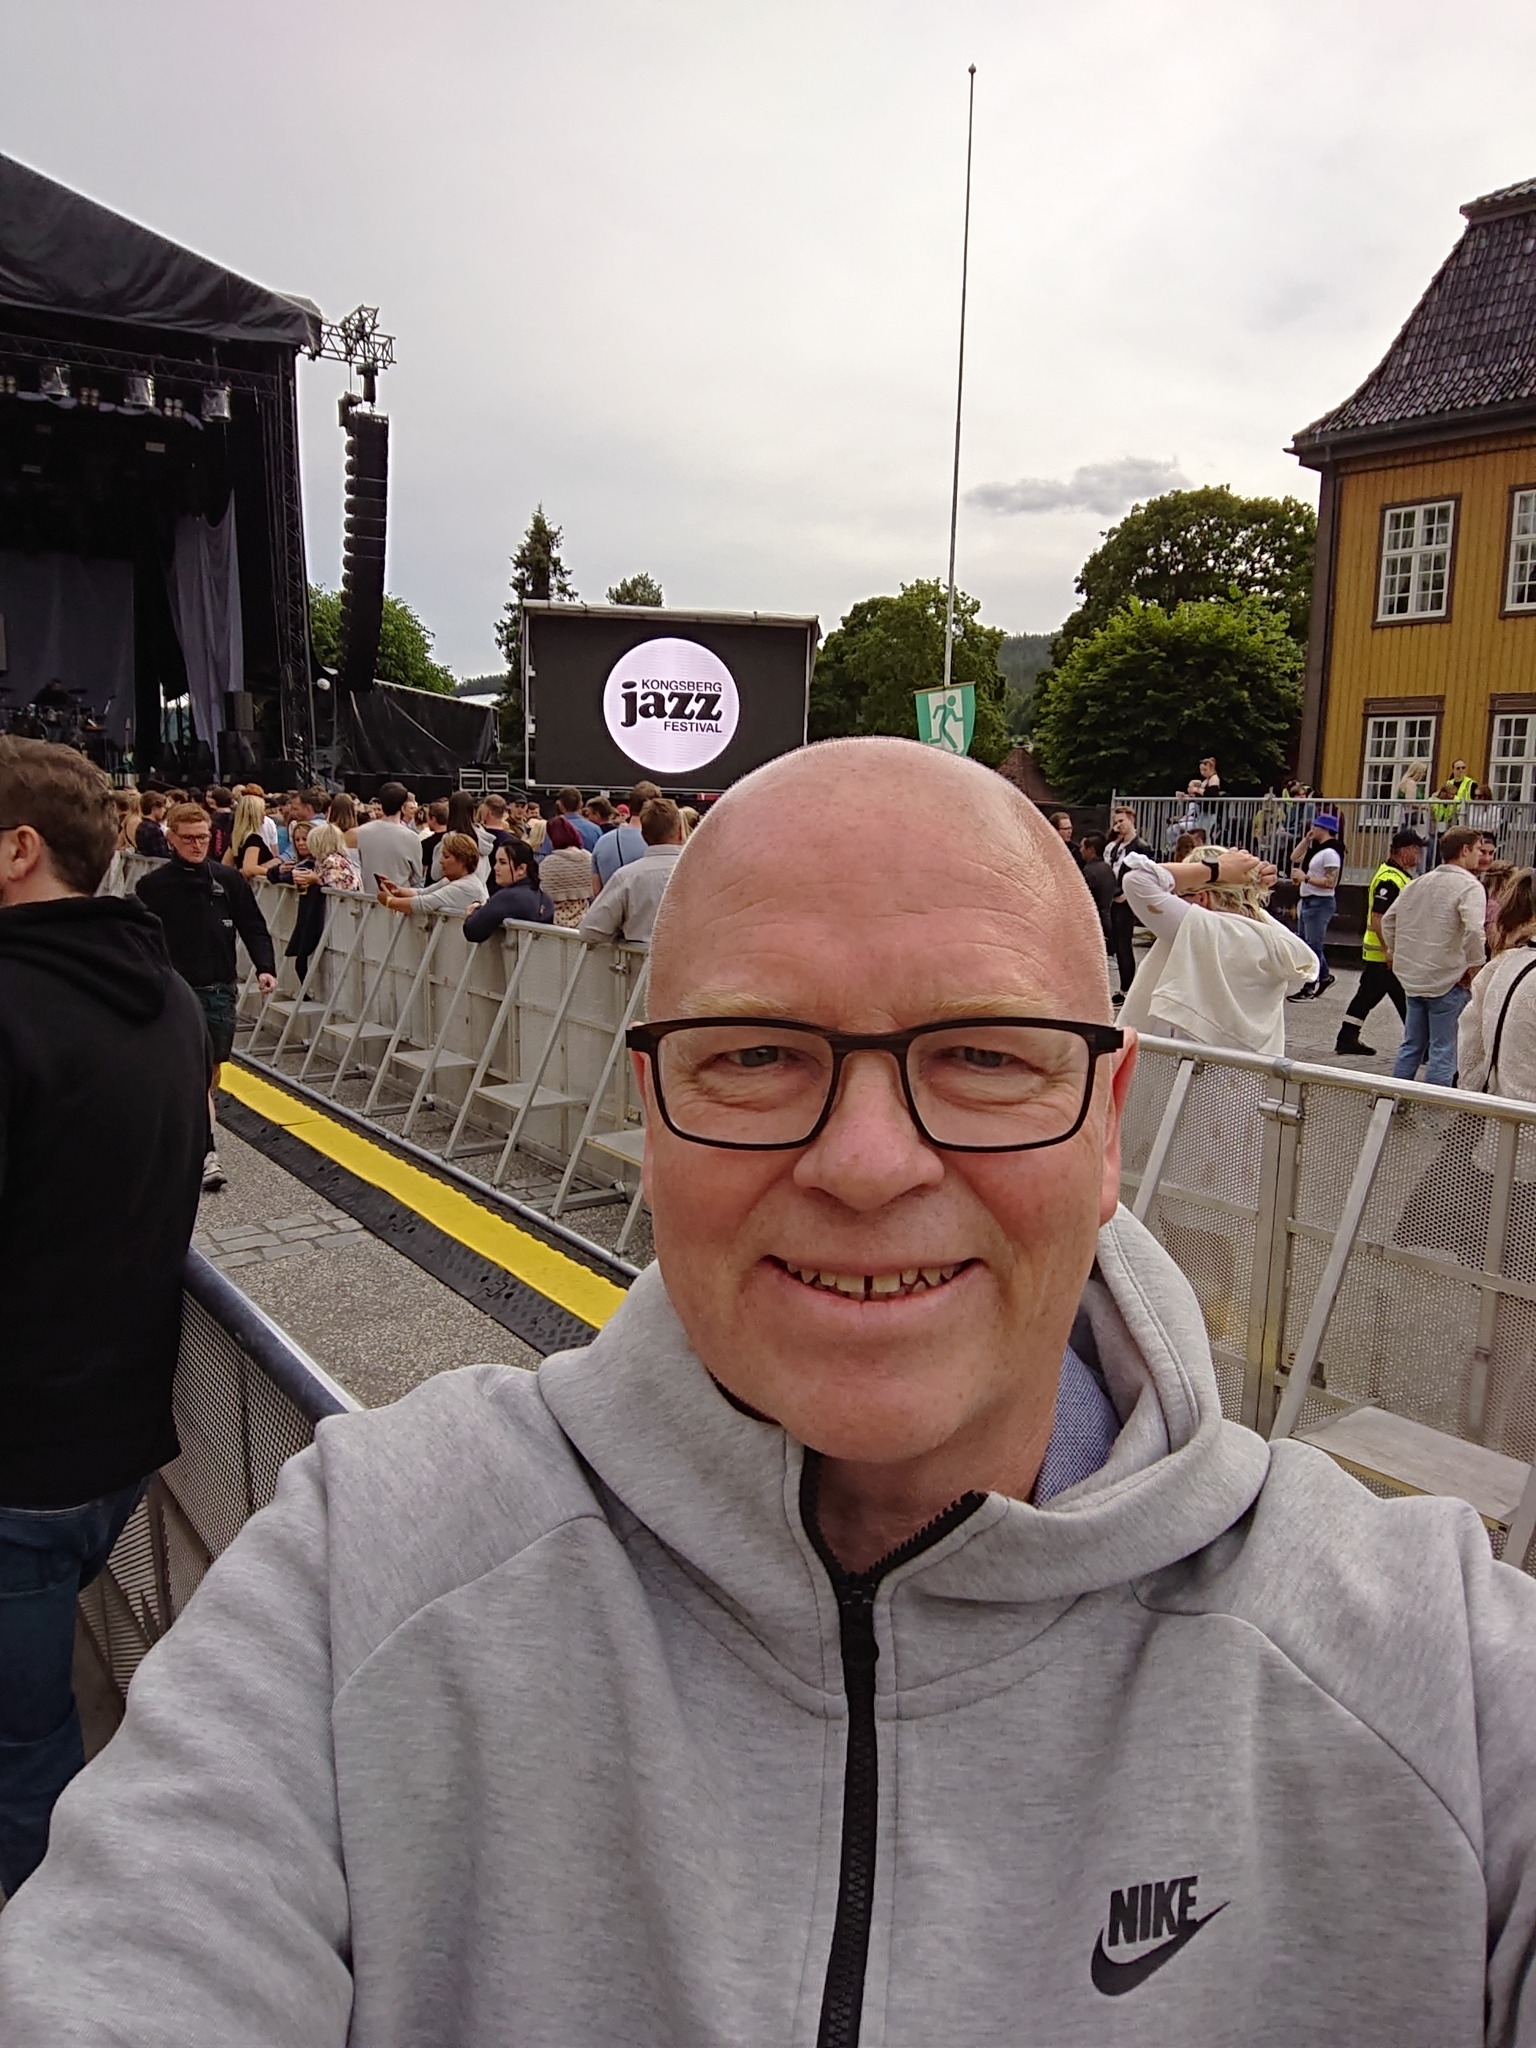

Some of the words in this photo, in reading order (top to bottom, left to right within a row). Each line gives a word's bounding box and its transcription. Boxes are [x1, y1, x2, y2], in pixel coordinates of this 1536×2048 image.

[641, 679, 722, 692] KONGSBERG
[621, 681, 722, 727] jazz
[664, 721, 722, 733] FESTIVAL
[1109, 1876, 1197, 1946] NIKE
